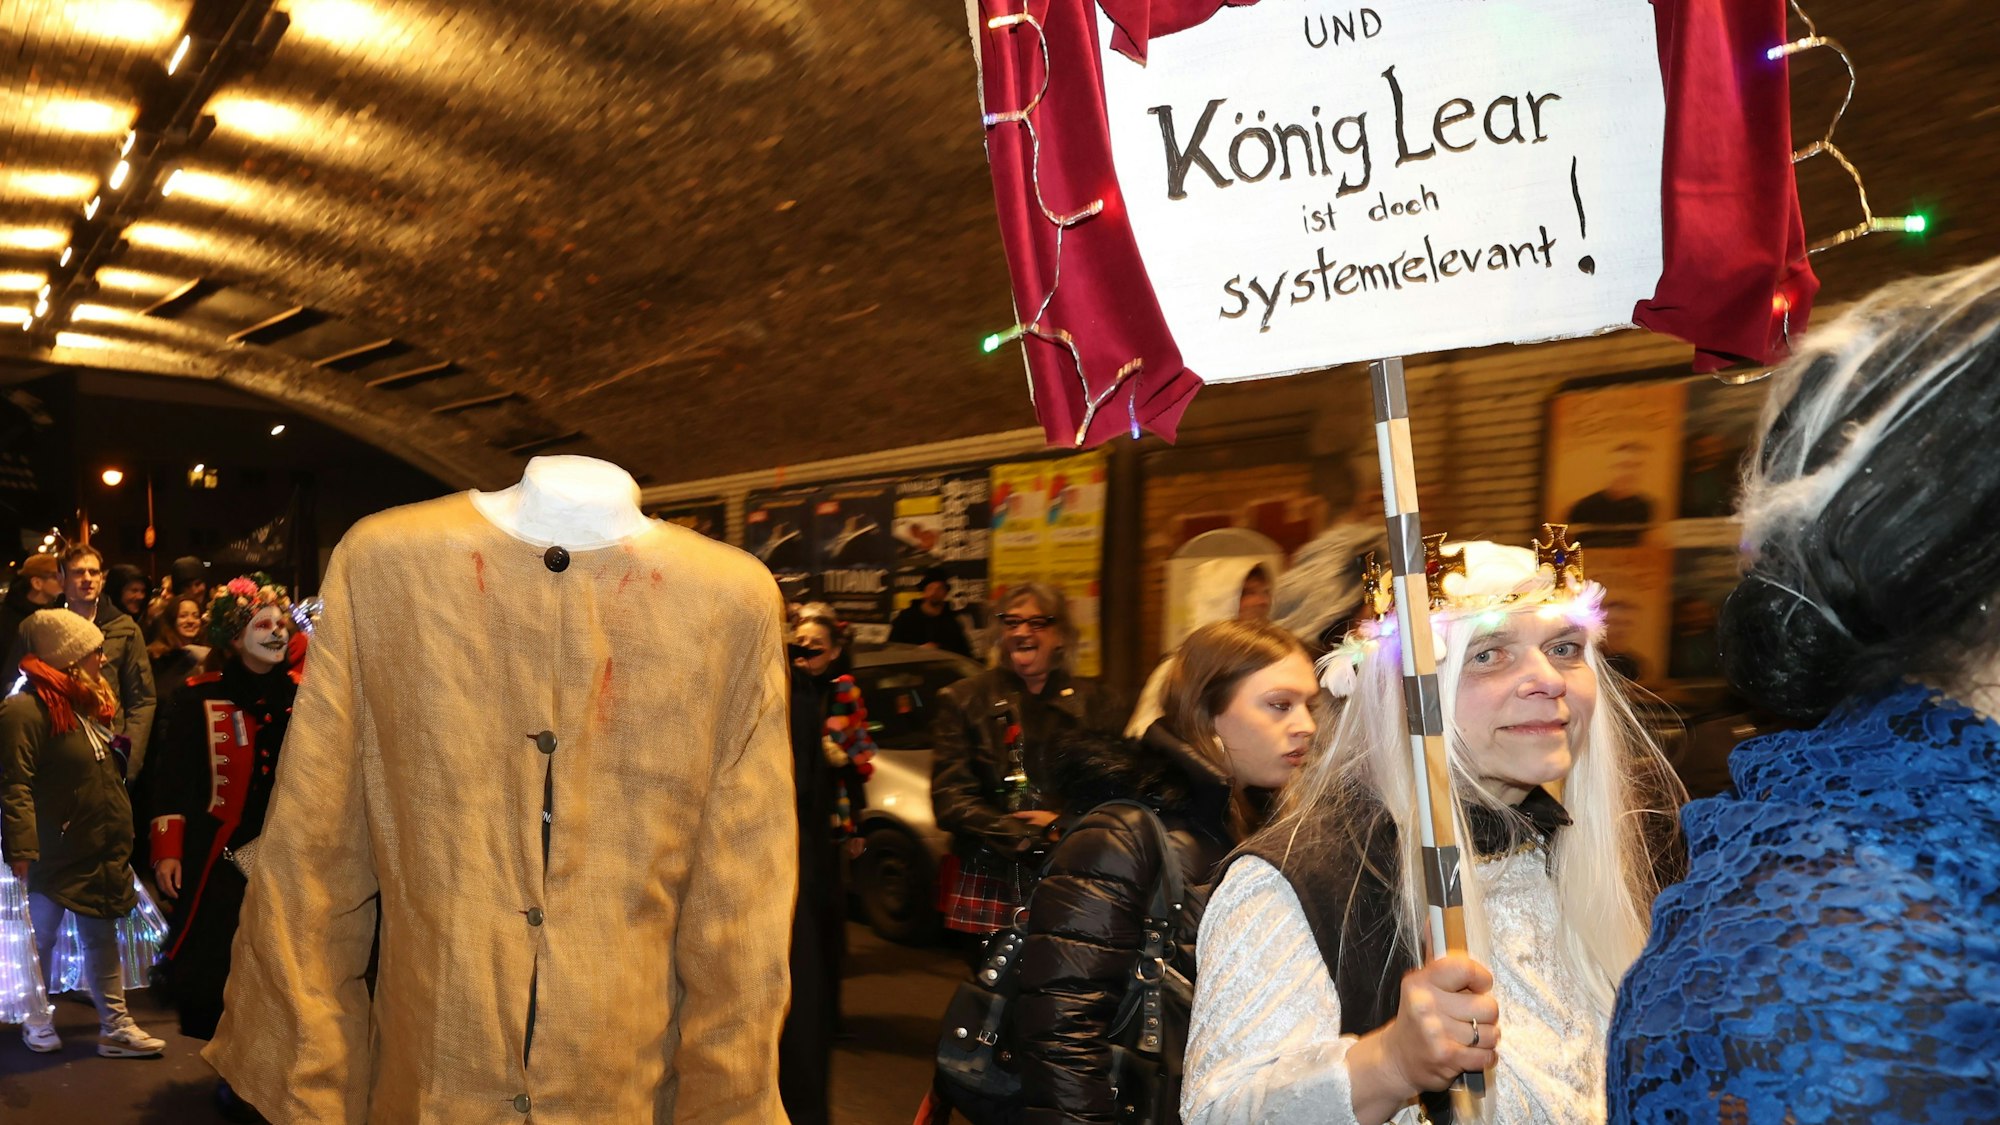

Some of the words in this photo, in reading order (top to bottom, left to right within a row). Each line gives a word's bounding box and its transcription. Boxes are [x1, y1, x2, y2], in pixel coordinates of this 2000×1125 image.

[1304, 7, 1382, 49] UND
[1147, 98, 1372, 200] König
[1380, 64, 1562, 169] Lear
[1303, 202, 1336, 235] ist
[1368, 184, 1439, 222] doch
